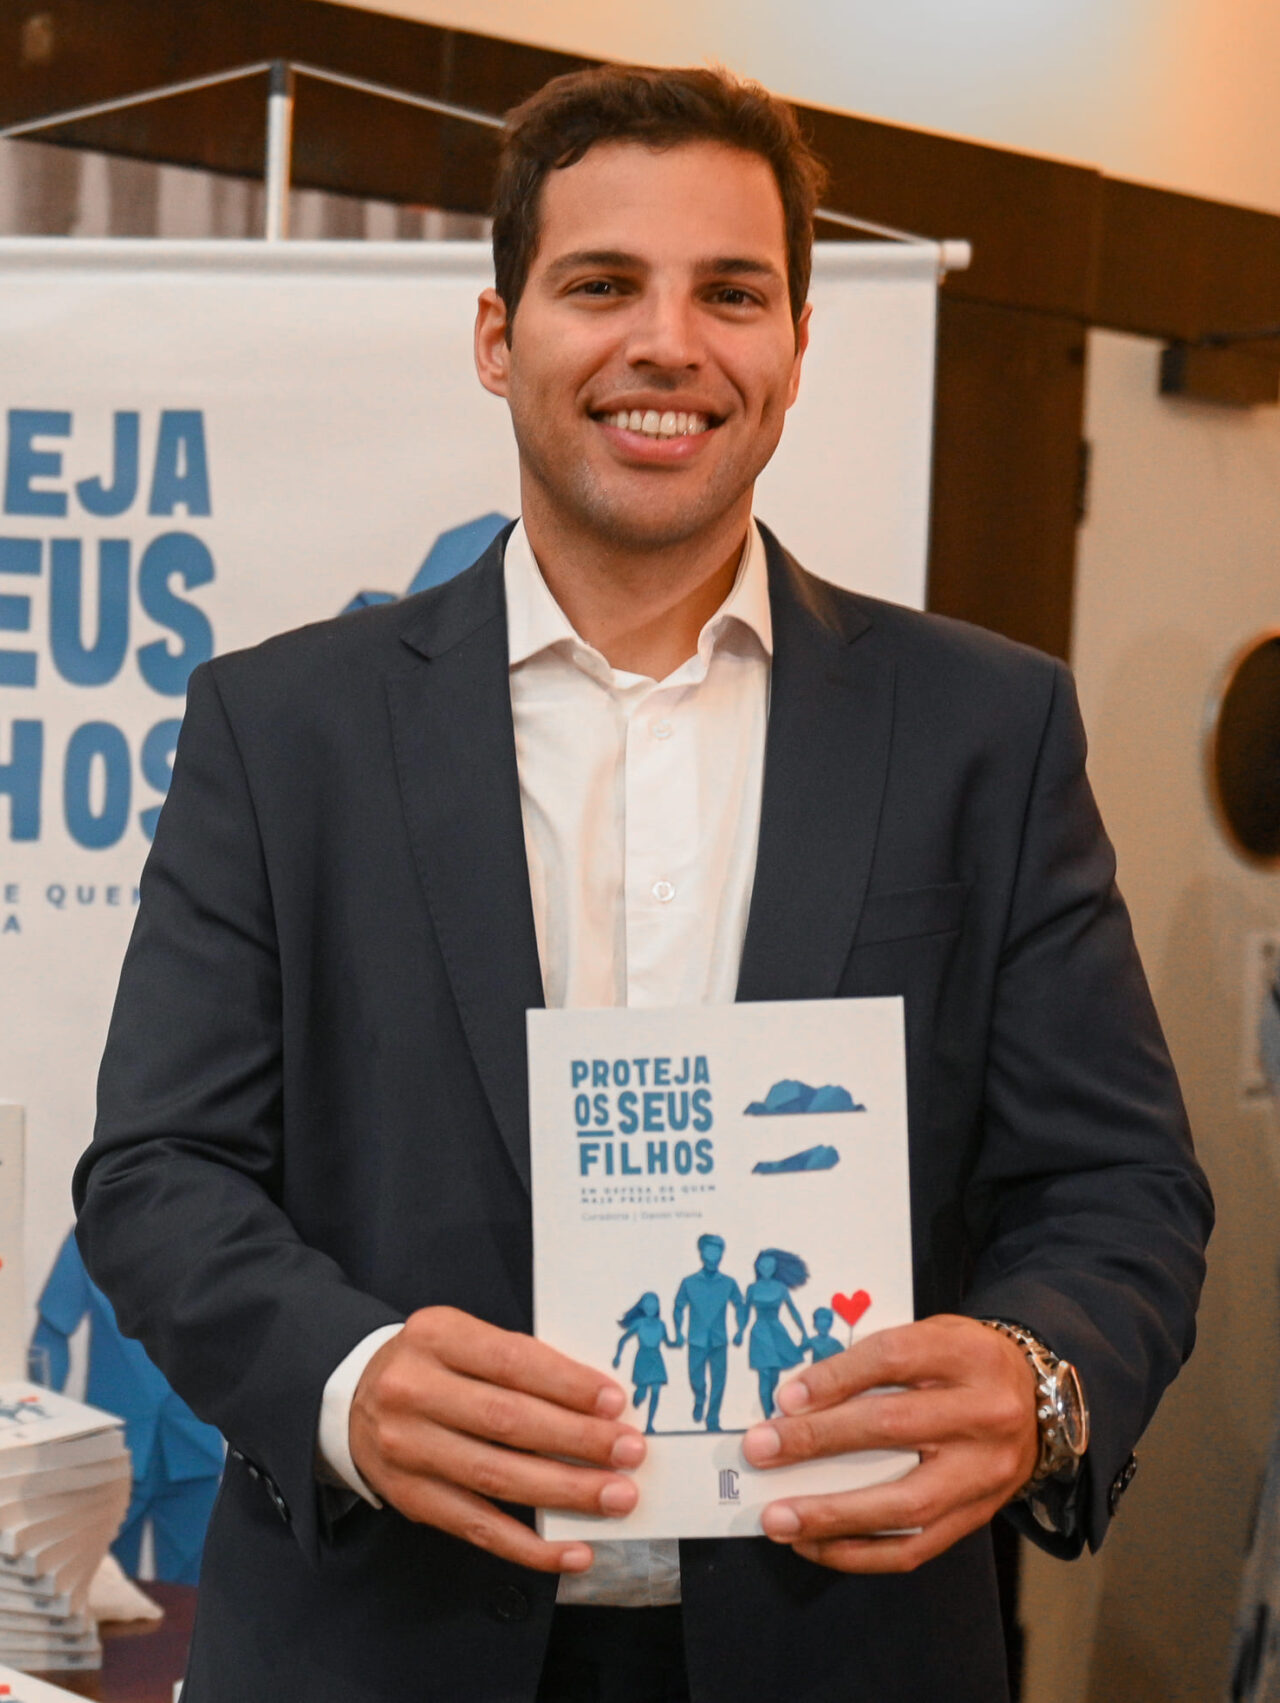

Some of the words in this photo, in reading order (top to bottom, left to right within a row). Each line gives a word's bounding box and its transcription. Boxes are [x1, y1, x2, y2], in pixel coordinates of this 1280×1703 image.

[571, 1055, 710, 1089] PROTEJA
[575, 1093, 609, 1127] OS
[618, 1088, 713, 1135] SEUS
[579, 1138, 714, 1176] FILHOS
